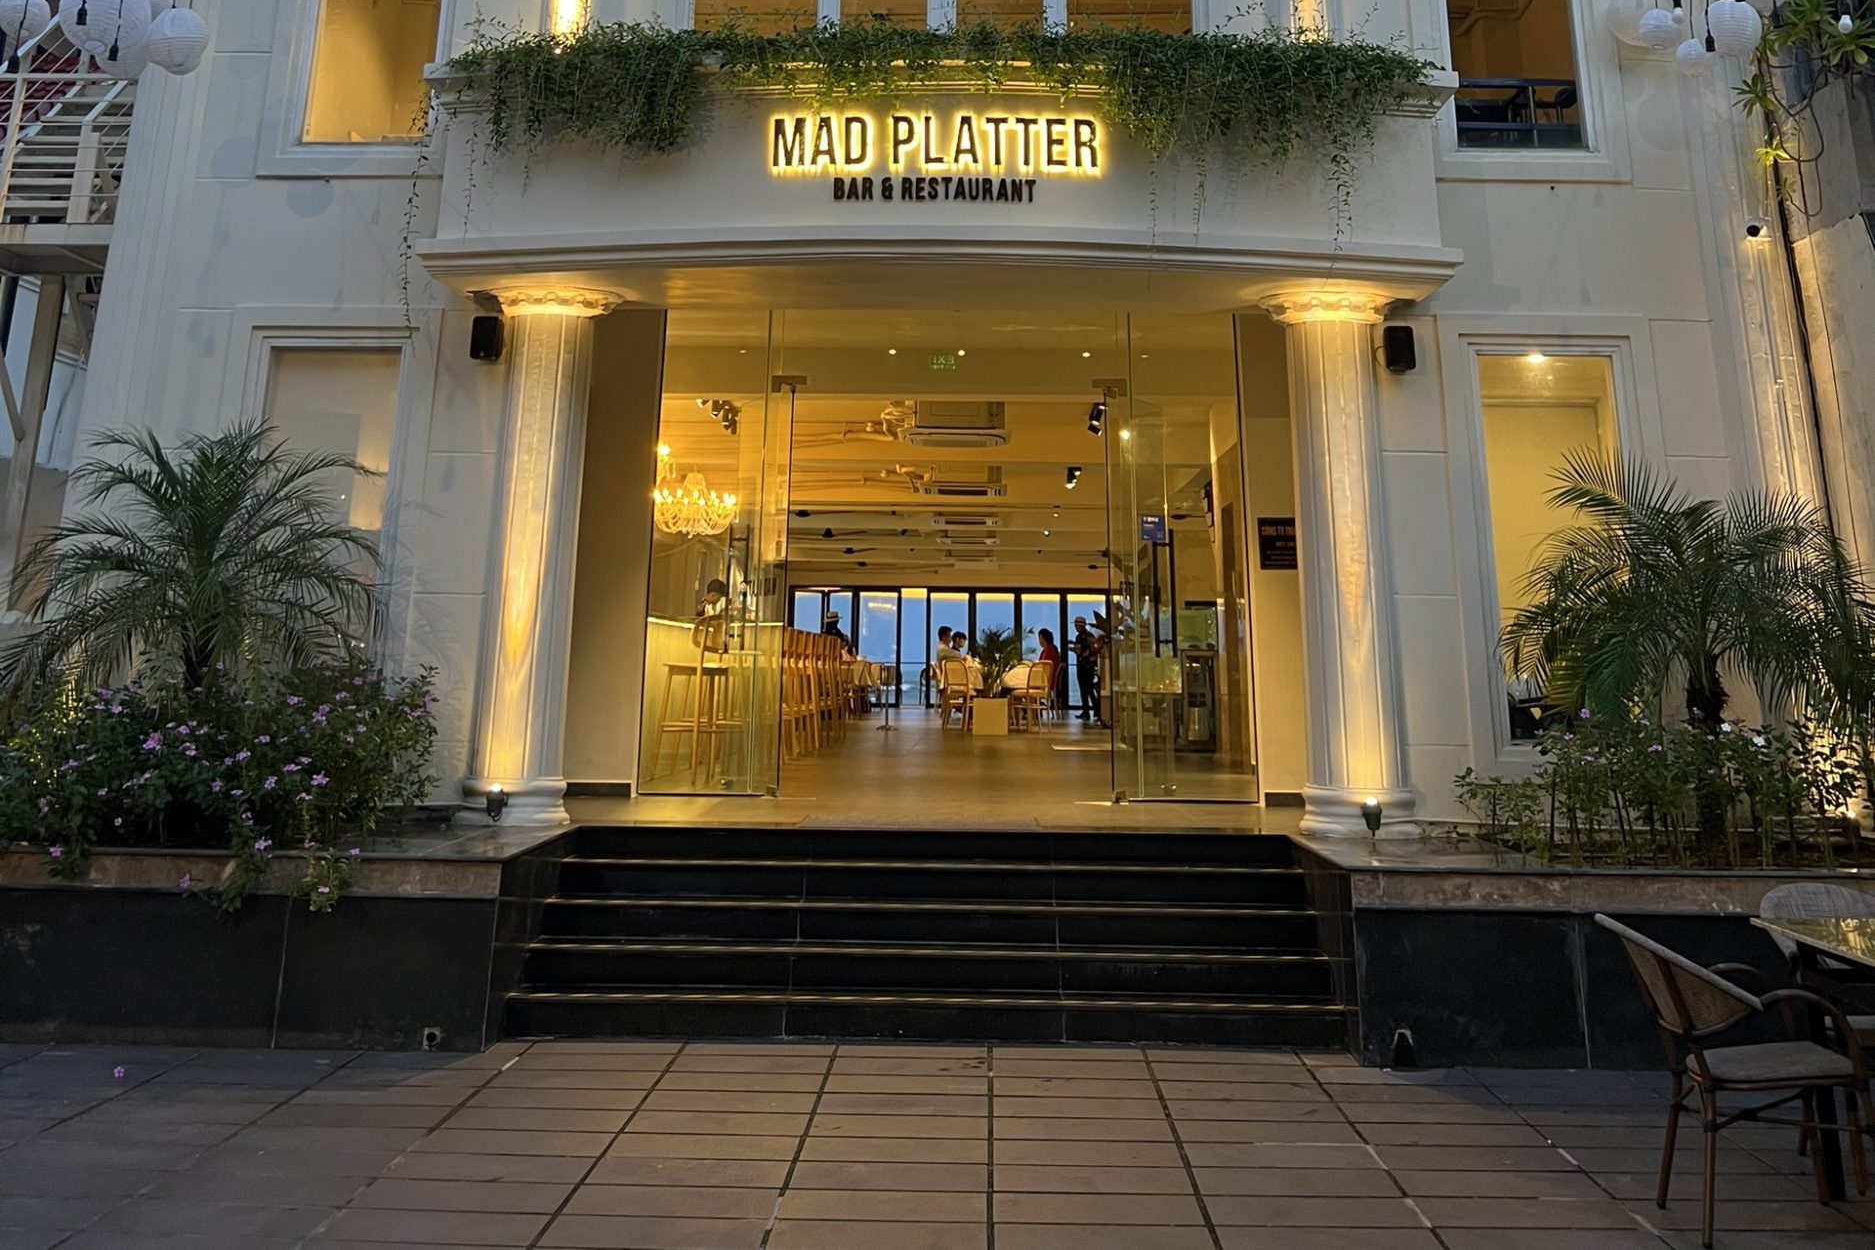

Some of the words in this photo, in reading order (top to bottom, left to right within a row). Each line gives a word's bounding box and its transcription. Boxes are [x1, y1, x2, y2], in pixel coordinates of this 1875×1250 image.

[772, 116, 867, 166] MAD
[891, 115, 1098, 167] PLATTER
[833, 177, 873, 201] BAR
[881, 177, 893, 200] &
[901, 177, 1037, 203] RESTAURANT
